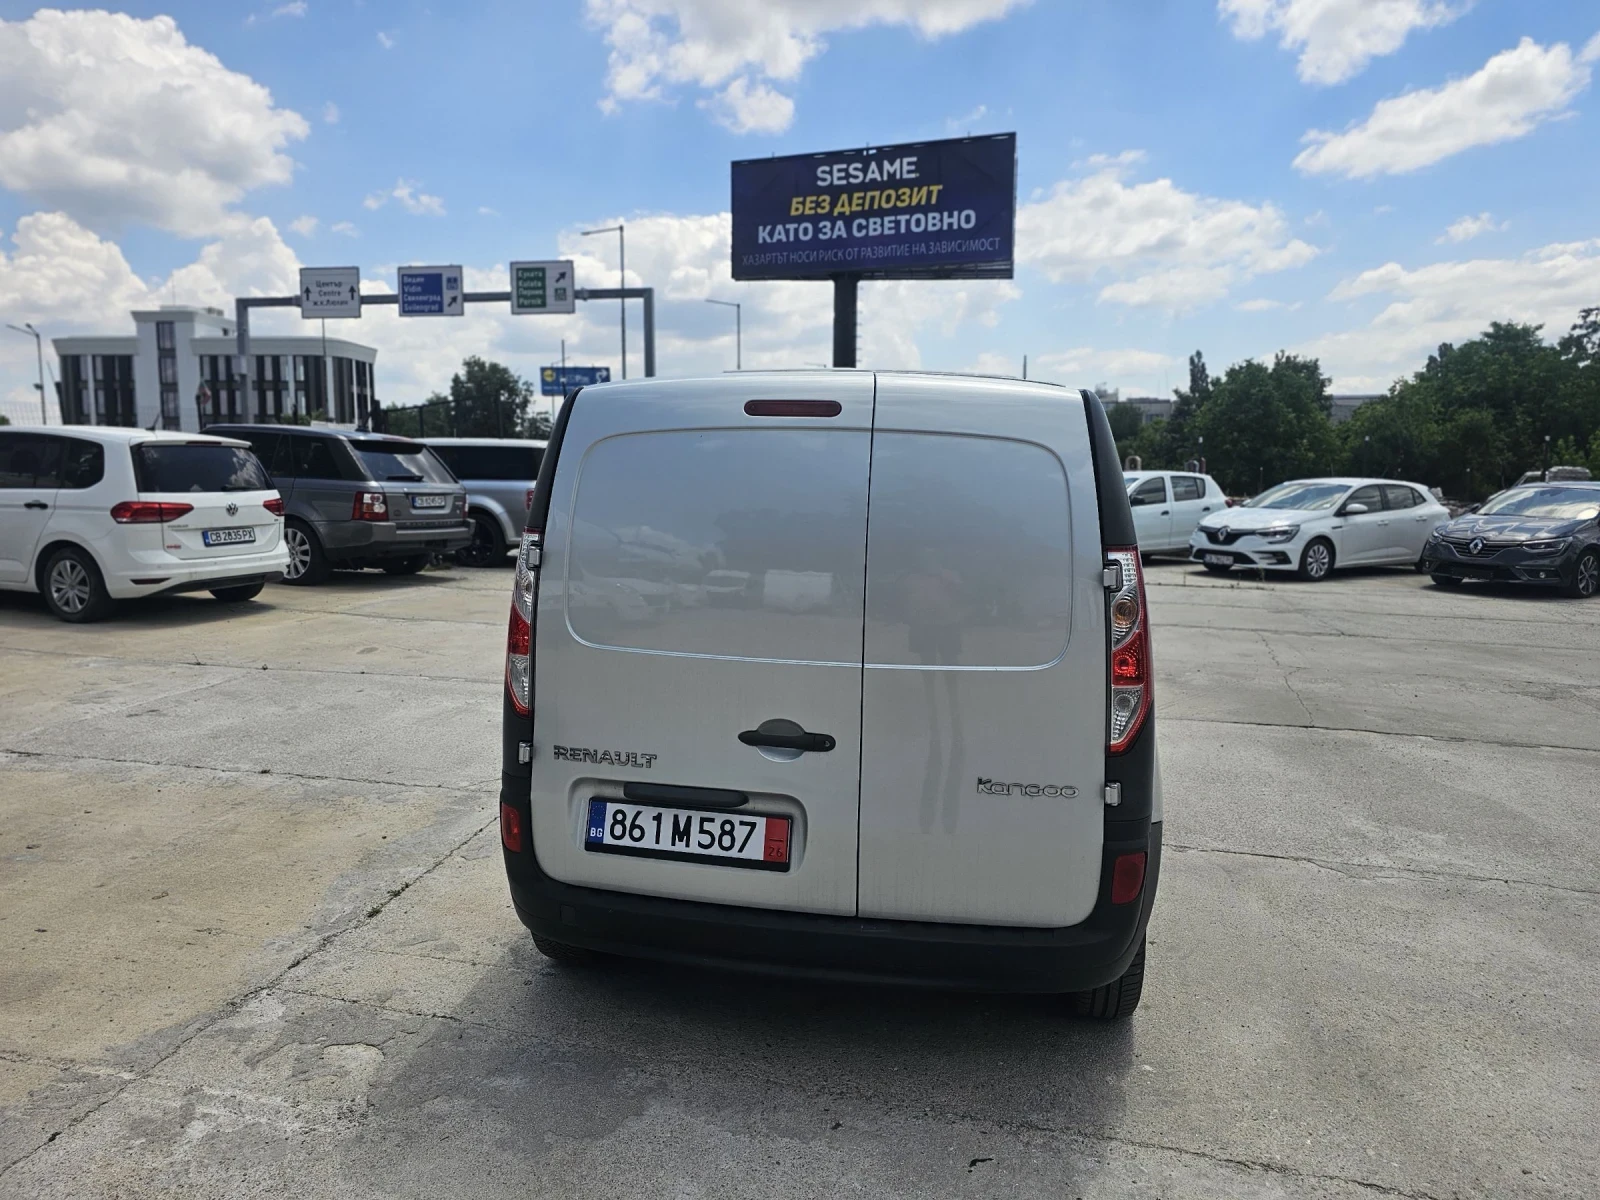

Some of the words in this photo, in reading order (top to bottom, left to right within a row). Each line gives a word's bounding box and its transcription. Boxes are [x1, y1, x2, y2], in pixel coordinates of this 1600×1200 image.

[789, 195, 831, 216] БЕЗ
[833, 184, 943, 216] ДЕПОЗИТ
[757, 221, 814, 244] КАТО
[817, 219, 848, 240] ЗА
[851, 209, 977, 237] СВЕТОВНО
[741, 252, 788, 266] ХАЗАРТЪТ
[789, 250, 818, 263] НОСИ
[819, 248, 845, 261] РИСК
[847, 248, 859, 261] ОТ
[860, 243, 911, 259] РАЗВИТИЕ
[911, 241, 926, 255] НА
[928, 237, 1001, 255] ЗАВИСИМОСТ
[210, 532, 222, 543] CB
[223, 530, 242, 542] 2835
[243, 529, 255, 540] PX
[553, 745, 658, 768] RENAULT
[977, 776, 1080, 799] Kangoo
[590, 827, 603, 838] BG
[768, 846, 783, 858] 26
